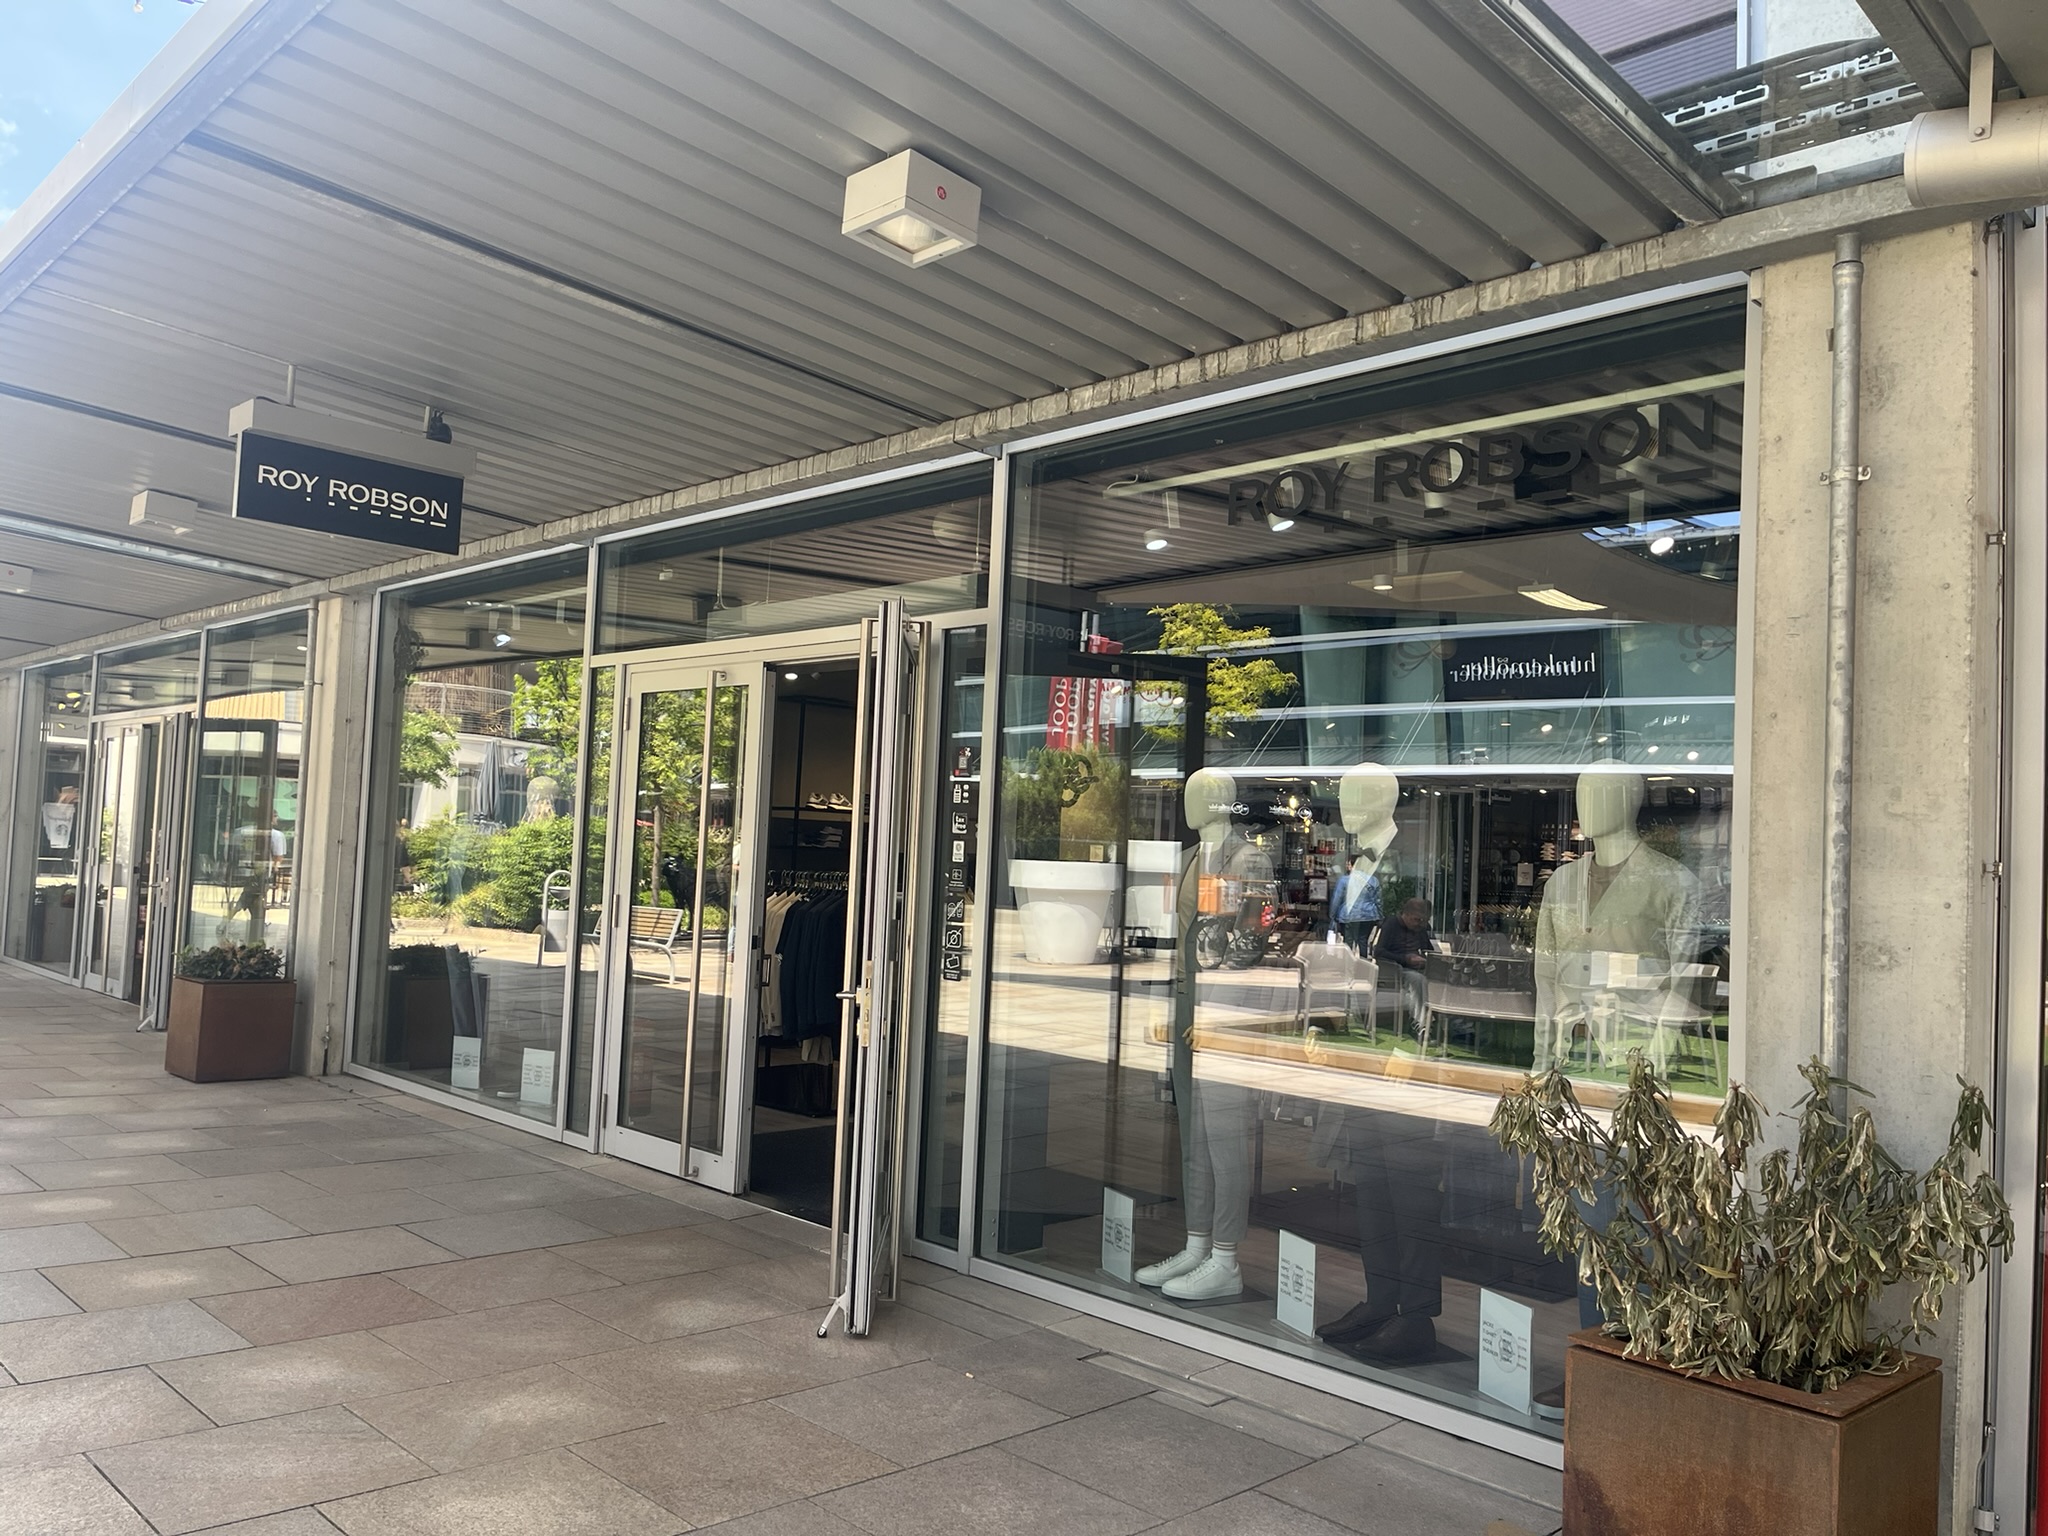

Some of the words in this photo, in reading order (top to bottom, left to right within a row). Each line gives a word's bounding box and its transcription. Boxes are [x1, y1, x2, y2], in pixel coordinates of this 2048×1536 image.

[257, 464, 320, 493] ROY
[328, 478, 449, 520] ROBSON
[1227, 461, 1352, 527] ROY
[1373, 394, 1714, 504] ROBSON
